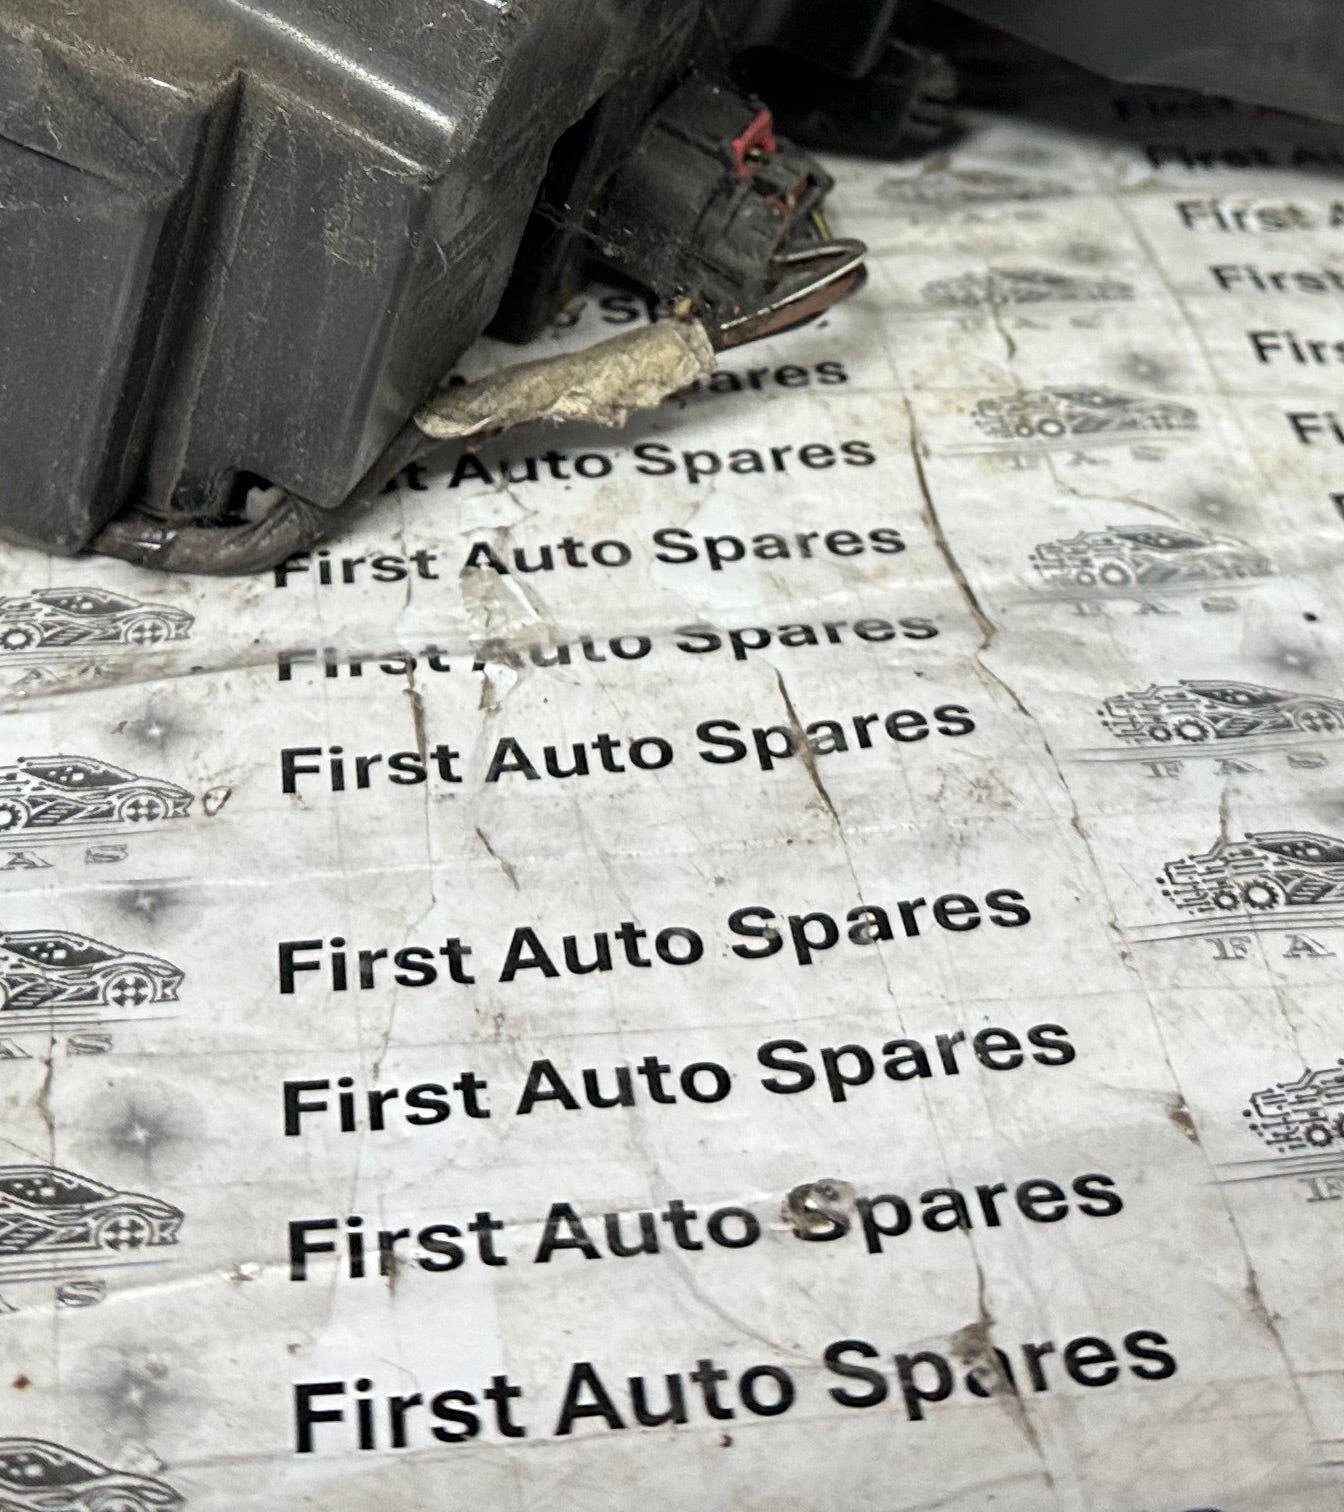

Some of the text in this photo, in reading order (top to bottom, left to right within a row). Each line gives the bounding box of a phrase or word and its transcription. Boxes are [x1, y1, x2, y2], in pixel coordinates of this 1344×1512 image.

[1175, 197, 1314, 233] First
[687, 360, 849, 398] ares
[448, 446, 616, 490] Auto
[632, 436, 877, 485] Spares
[270, 527, 907, 589] First Auto Spares
[674, 617, 940, 662] Spares
[280, 698, 976, 796] First Auto Spares
[278, 888, 1032, 995] First Auto Spares
[283, 1023, 1077, 1137] First Auto Spares
[288, 1173, 1124, 1285] First Auto Spares
[293, 1324, 1178, 1454] First Auto Spares
